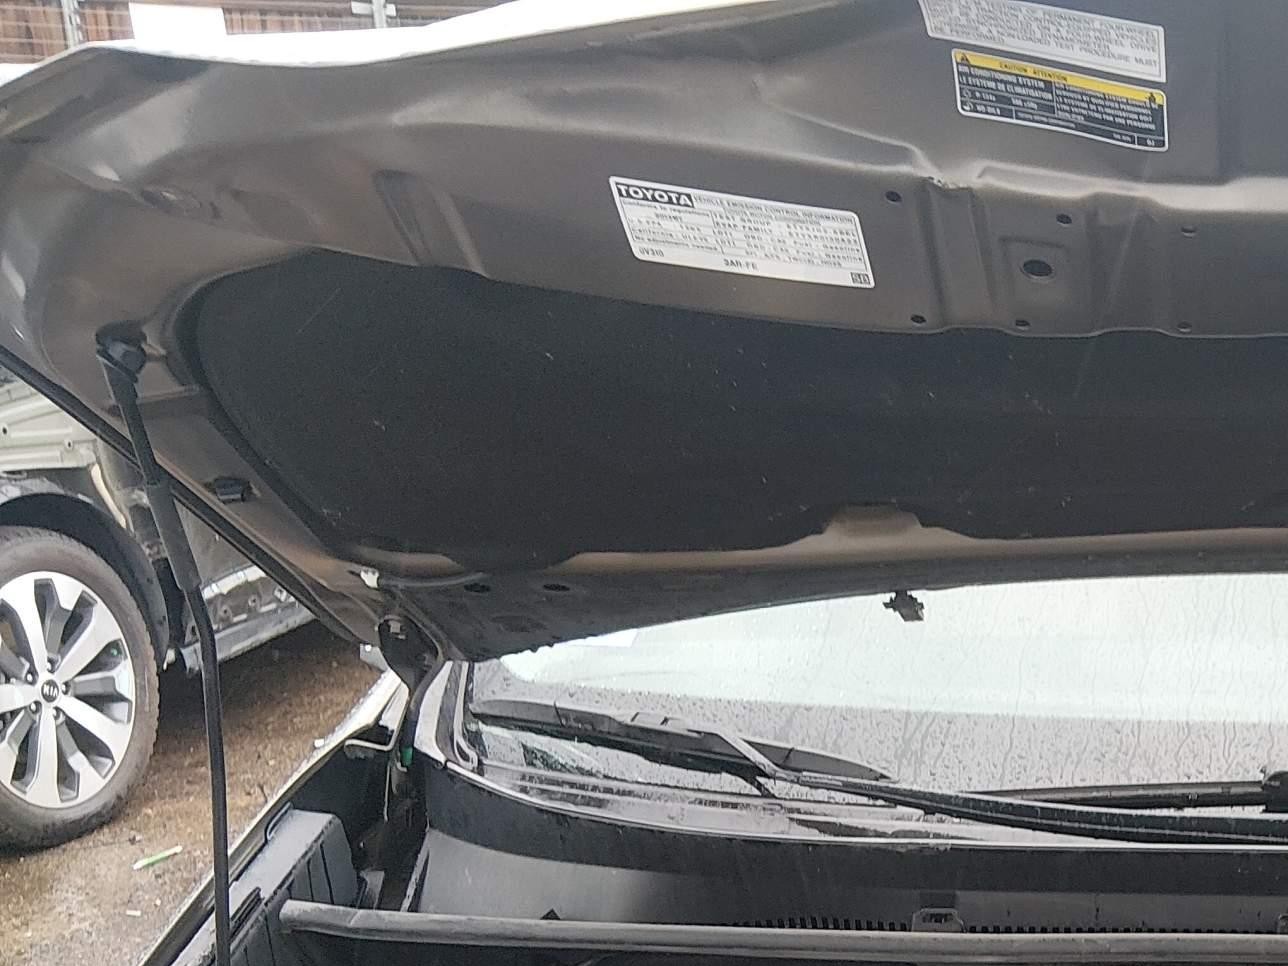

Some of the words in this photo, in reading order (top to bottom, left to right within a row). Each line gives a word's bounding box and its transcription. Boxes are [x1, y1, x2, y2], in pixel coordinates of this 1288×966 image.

[999, 62, 1028, 74] CAUTION
[1032, 69, 1068, 82] ATTENTION
[616, 184, 692, 206] TOYOTA
[43, 684, 58, 697] KIA
